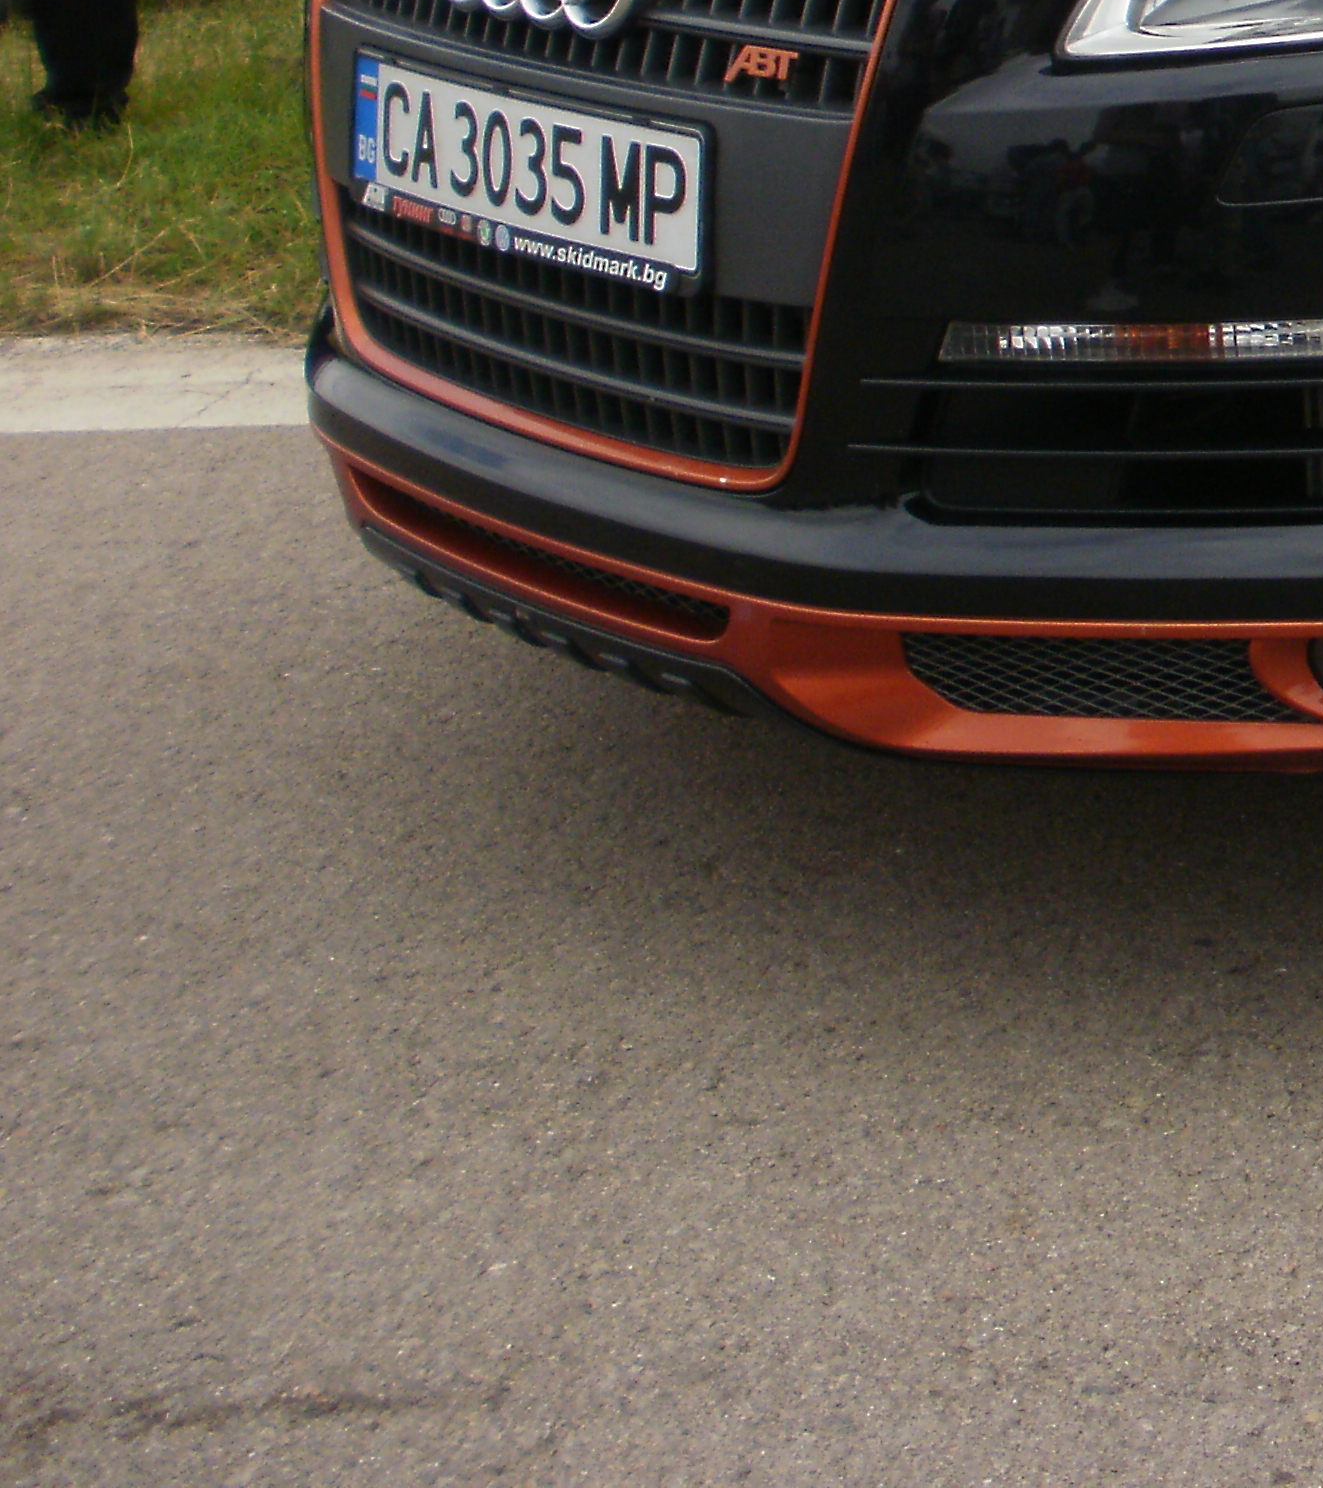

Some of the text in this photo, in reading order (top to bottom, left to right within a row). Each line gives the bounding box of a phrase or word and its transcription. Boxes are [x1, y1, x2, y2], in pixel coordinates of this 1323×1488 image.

[723, 44, 798, 83] ABT
[357, 132, 377, 164] BG
[382, 80, 688, 246] CA 3035 MP
[513, 235, 668, 292] www.skidmark.bg
